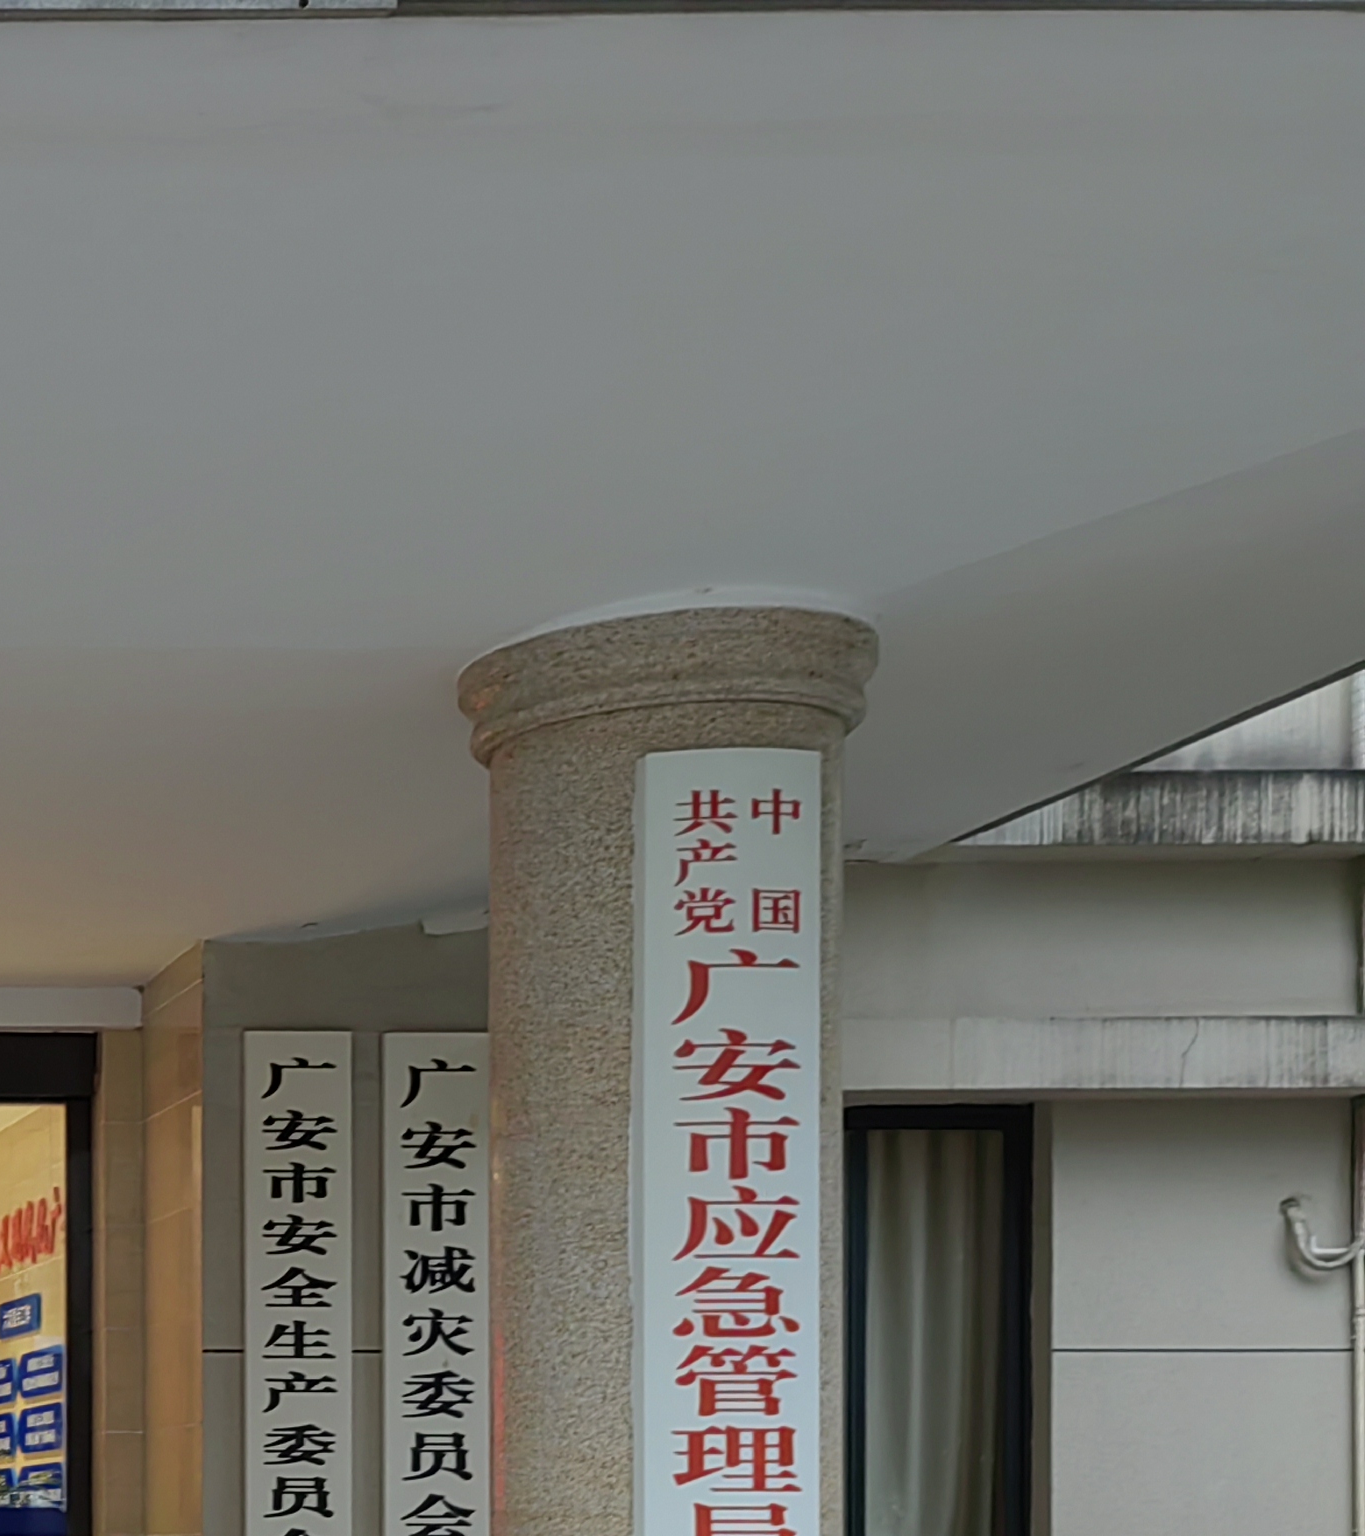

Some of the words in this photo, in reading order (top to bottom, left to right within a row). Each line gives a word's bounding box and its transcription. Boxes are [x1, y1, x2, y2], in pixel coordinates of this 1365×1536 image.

[674, 788, 737, 936] 共产党
[751, 788, 802, 934] 中国
